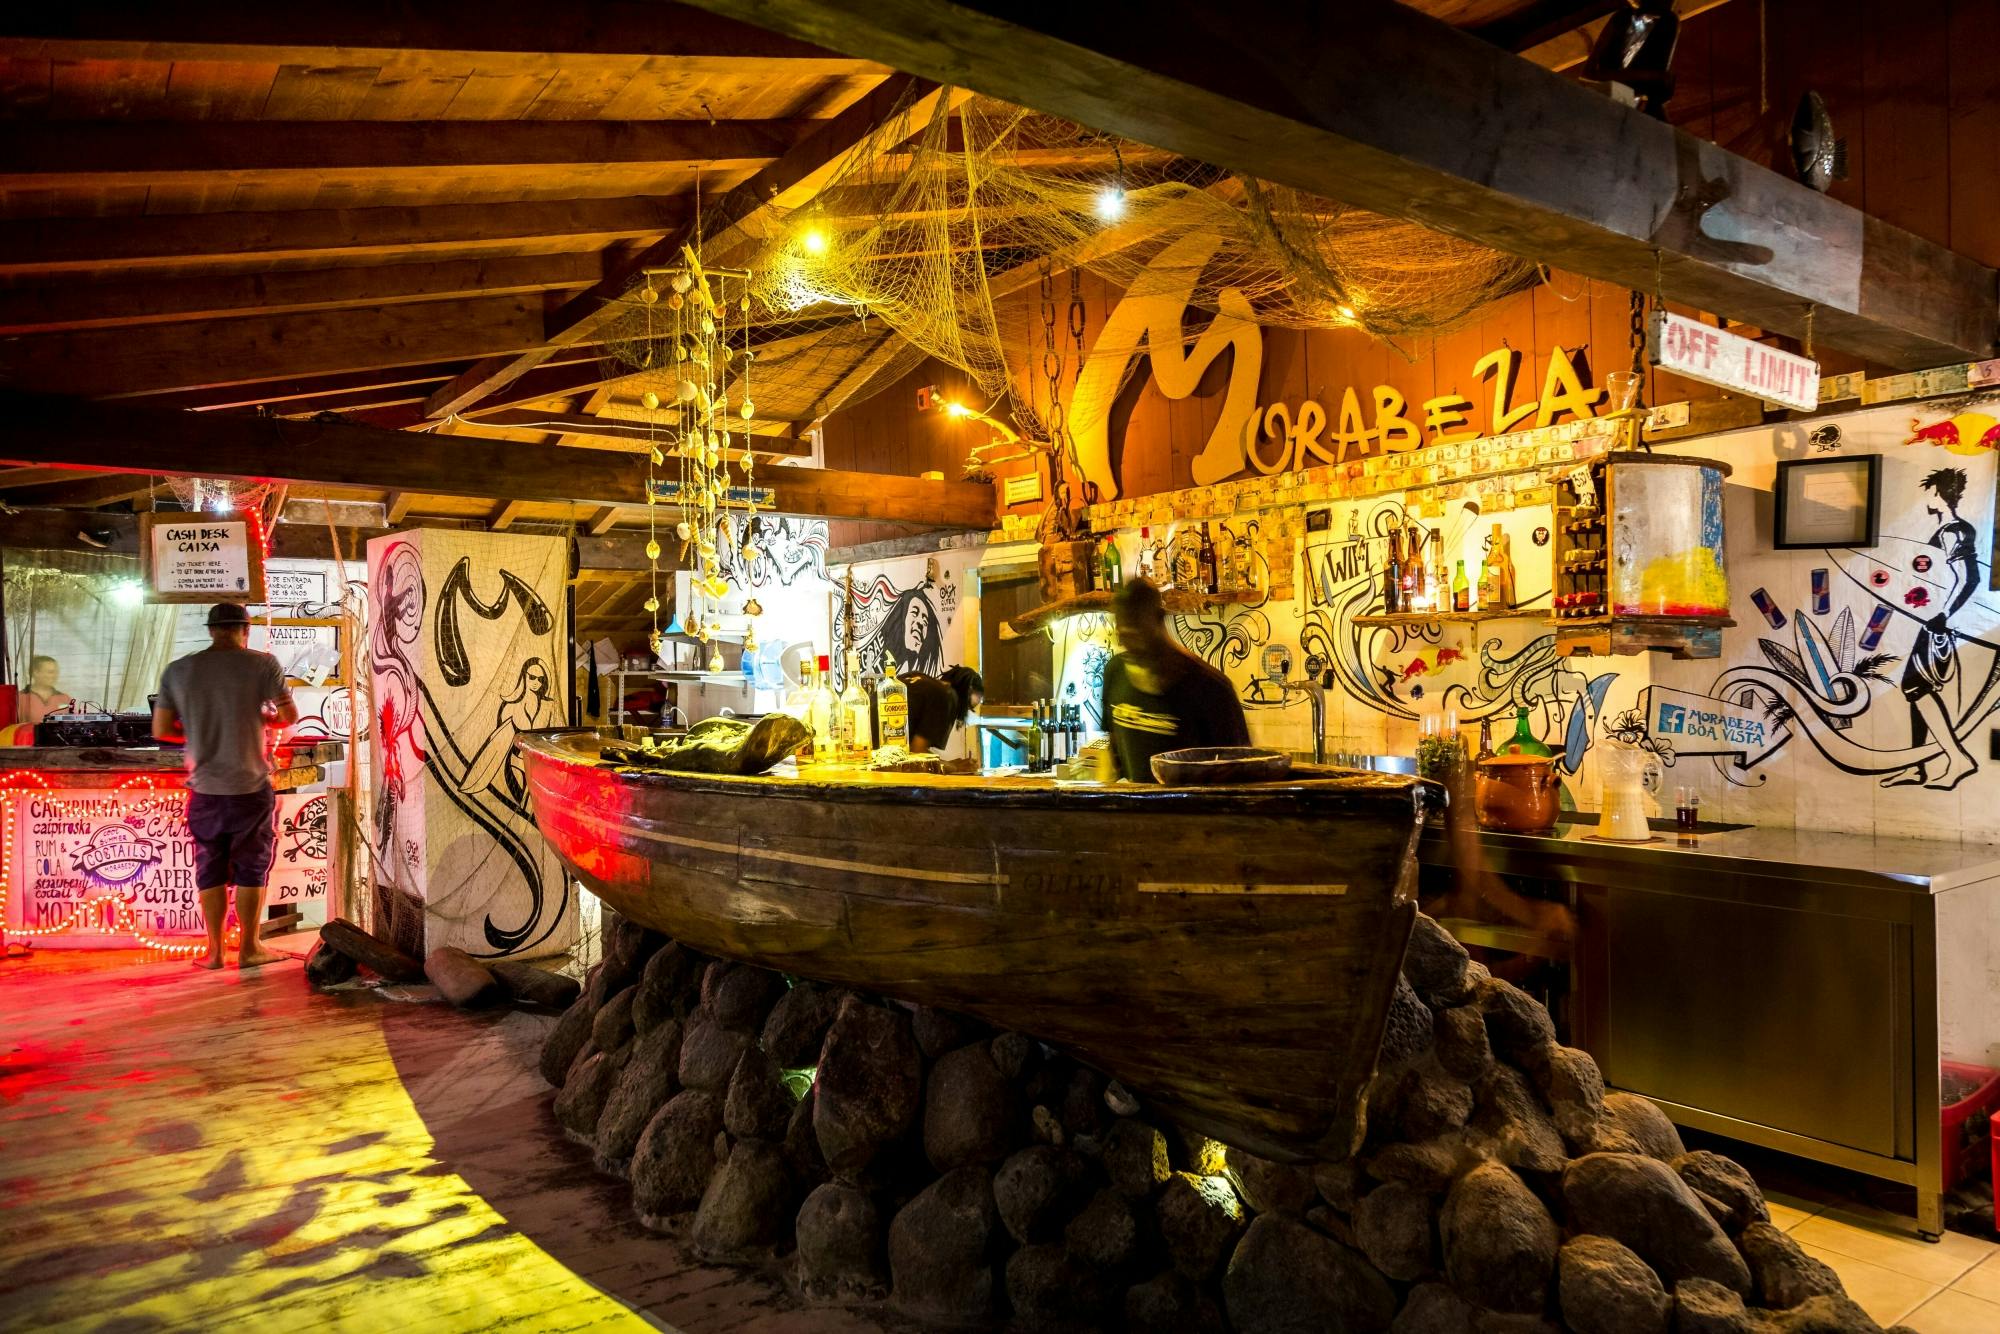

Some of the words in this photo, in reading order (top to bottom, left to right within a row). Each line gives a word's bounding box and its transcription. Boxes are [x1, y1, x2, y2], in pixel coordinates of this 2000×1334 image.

[1067, 231, 1601, 501] MORABEZA
[1667, 321, 1719, 370] OFF
[1743, 346, 1811, 401] LIMIT
[166, 529, 196, 541] CASH
[201, 528, 230, 540] DESK
[178, 542, 220, 552] CAIXA
[1325, 542, 1370, 584] WIFI
[283, 576, 312, 584] ENTRADA
[332, 701, 343, 712] NO
[333, 713, 344, 729] NO
[1688, 709, 1765, 736] MORABEZA
[1688, 723, 1718, 741] BOA
[1722, 728, 1764, 747] VISTA
[30, 799, 121, 818] CAIPIRINHA
[32, 818, 91, 838] caipiroska
[146, 817, 193, 838] CAM
[35, 840, 57, 857] RUM
[60, 842, 67, 854] &
[36, 858, 62, 877] COLA
[303, 868, 315, 878] TO
[279, 885, 299, 900] DO
[305, 881, 328, 898] NOT
